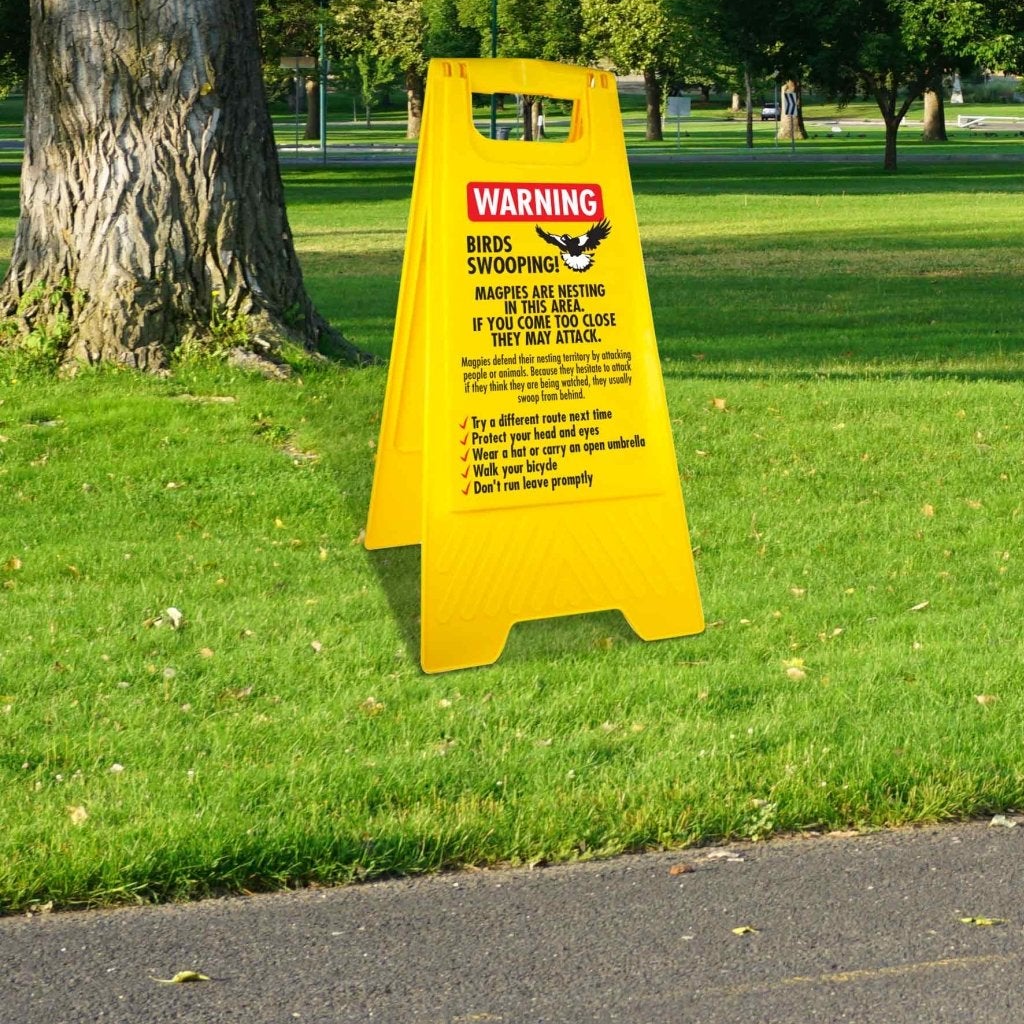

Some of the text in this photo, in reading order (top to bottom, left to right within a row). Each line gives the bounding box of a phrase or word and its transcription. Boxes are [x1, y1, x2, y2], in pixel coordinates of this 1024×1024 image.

[473, 188, 597, 216] WARNING
[467, 235, 512, 253] BIRDS
[468, 256, 560, 274] SWOOPING!
[475, 284, 606, 300] MAGPIES ARE NESTING
[504, 299, 584, 314] IN THIS AREA.
[473, 313, 616, 331] IF YOU COME TOO CLOSE
[491, 329, 602, 347] THEY MAY ATTACK.
[461, 349, 632, 369] Magpies defend their nesting territory by attacking
[463, 368, 487, 382] people
[498, 366, 528, 378] animals.
[530, 366, 558, 376] Because
[560, 364, 574, 375] they
[576, 363, 602, 374] hesitate
[603, 363, 610, 372] to
[612, 361, 632, 371] attack
[464, 373, 632, 394] if they think they are being watched, they usually
[517, 388, 585, 404] swoop from behind.
[471, 409, 612, 432] Try a different route next time
[472, 424, 599, 446] Protect your head and eyes
[472, 434, 645, 461] Wear a hat or carry an open umbrella
[473, 457, 557, 479] Walk your bicycle
[474, 470, 593, 494] Don't run leave promptly
